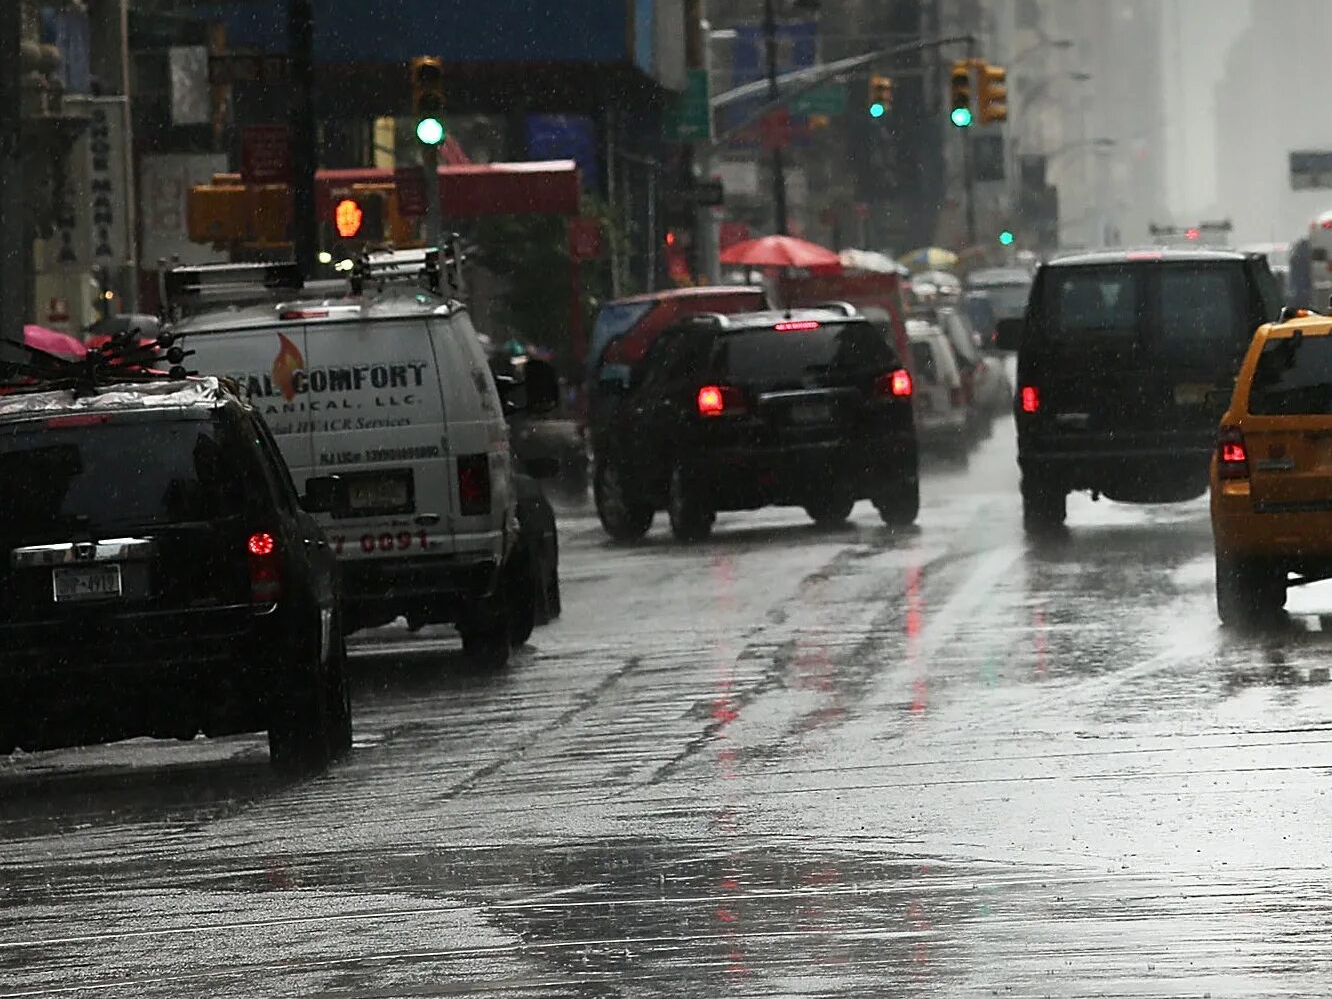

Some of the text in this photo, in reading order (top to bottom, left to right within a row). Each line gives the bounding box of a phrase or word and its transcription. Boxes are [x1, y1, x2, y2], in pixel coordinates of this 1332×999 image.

[92, 178, 113, 257] MANIA
[291, 362, 427, 394] COMFORT
[258, 398, 362, 415] ANICAL,
[355, 415, 411, 430] Services
[360, 529, 428, 553] 0091
